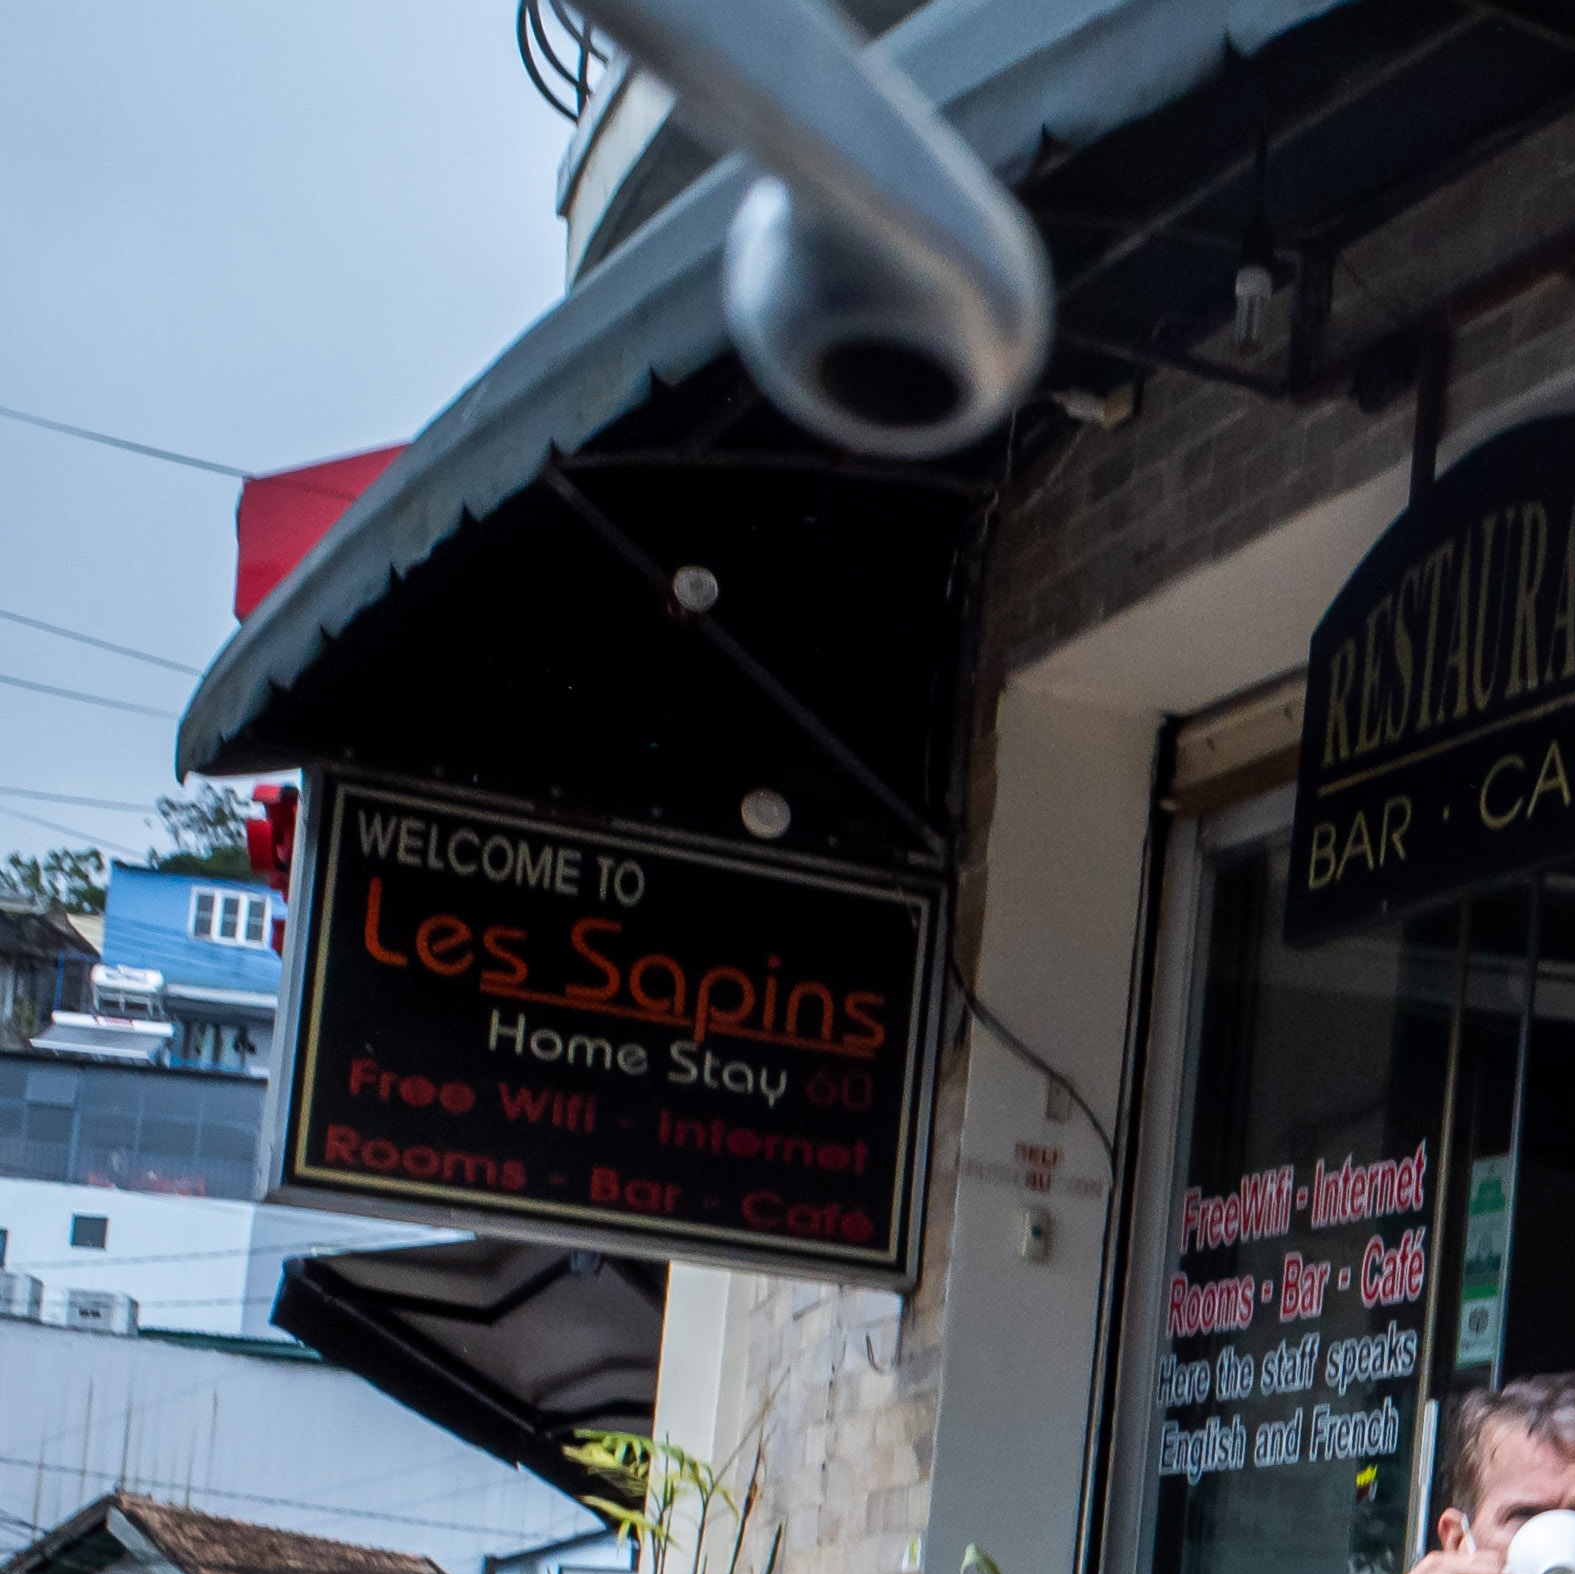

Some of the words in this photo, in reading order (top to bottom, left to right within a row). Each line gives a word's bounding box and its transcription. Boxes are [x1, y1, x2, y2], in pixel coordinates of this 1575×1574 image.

[358, 808, 581, 898] WELCOME
[599, 854, 646, 906] TO
[1308, 796, 1412, 891] BAR
[362, 876, 530, 995] Les
[562, 916, 888, 1061] Sapins
[488, 1009, 650, 1077] Home
[668, 1039, 788, 1108] Stay
[805, 1069, 874, 1112] 60
[349, 1056, 476, 1115] Free
[659, 1108, 870, 1176] Internet
[324, 1123, 528, 1192] Rooms
[589, 1166, 682, 1218] Bar
[741, 1189, 874, 1245] Café
[1180, 1164, 1294, 1254] FreeWifi
[1311, 1137, 1427, 1230] Internet
[1166, 1271, 1254, 1339] Rooms
[1279, 1252, 1330, 1321] Bar
[1361, 1226, 1425, 1309] Café
[1157, 1353, 1209, 1406] Here
[1216, 1346, 1254, 1400] the
[1261, 1332, 1320, 1396] staff
[1325, 1320, 1417, 1396] speaks
[1159, 1410, 1246, 1485] English
[1254, 1408, 1302, 1467] and
[1309, 1396, 1400, 1463] French
